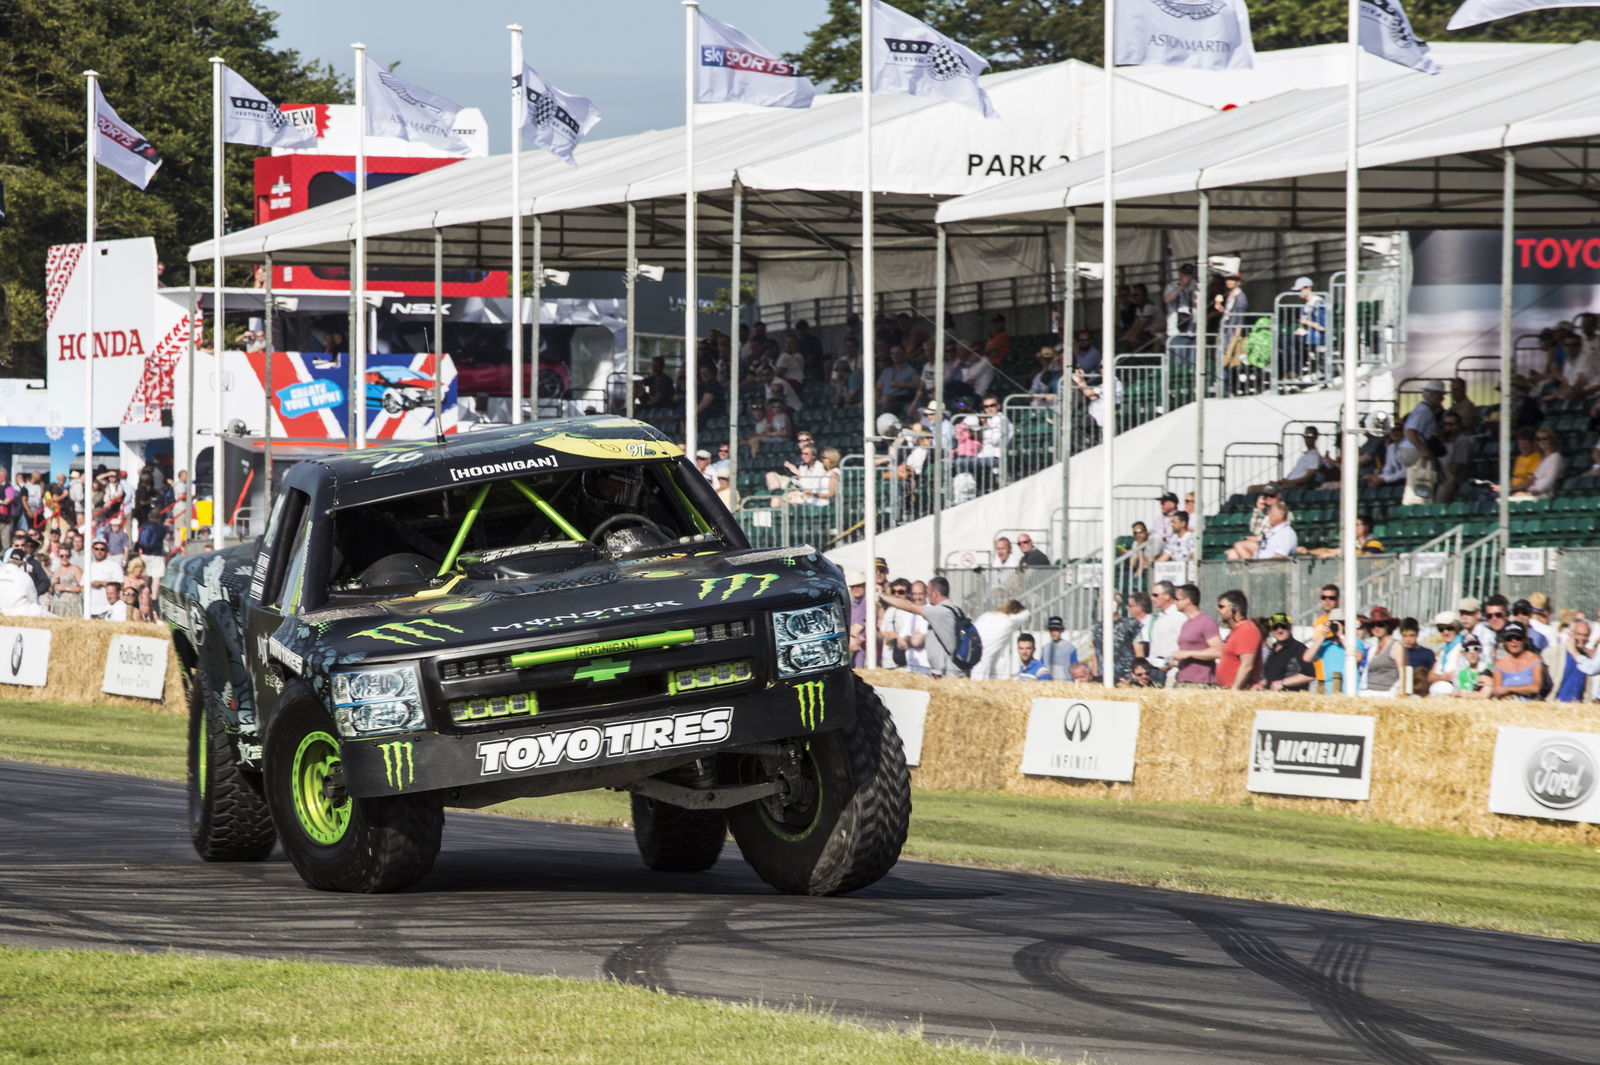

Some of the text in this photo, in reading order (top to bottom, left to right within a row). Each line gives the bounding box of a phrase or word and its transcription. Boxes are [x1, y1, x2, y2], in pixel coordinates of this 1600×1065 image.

[703, 46, 723, 66] sky
[724, 50, 789, 75] SPORTS
[967, 153, 1046, 177] PARK
[389, 302, 453, 316] NSX
[58, 329, 145, 361] HONDA
[475, 706, 734, 776] TOYO TIRES
[1275, 739, 1361, 767] MICHELIN
[1534, 748, 1585, 799] Ford
